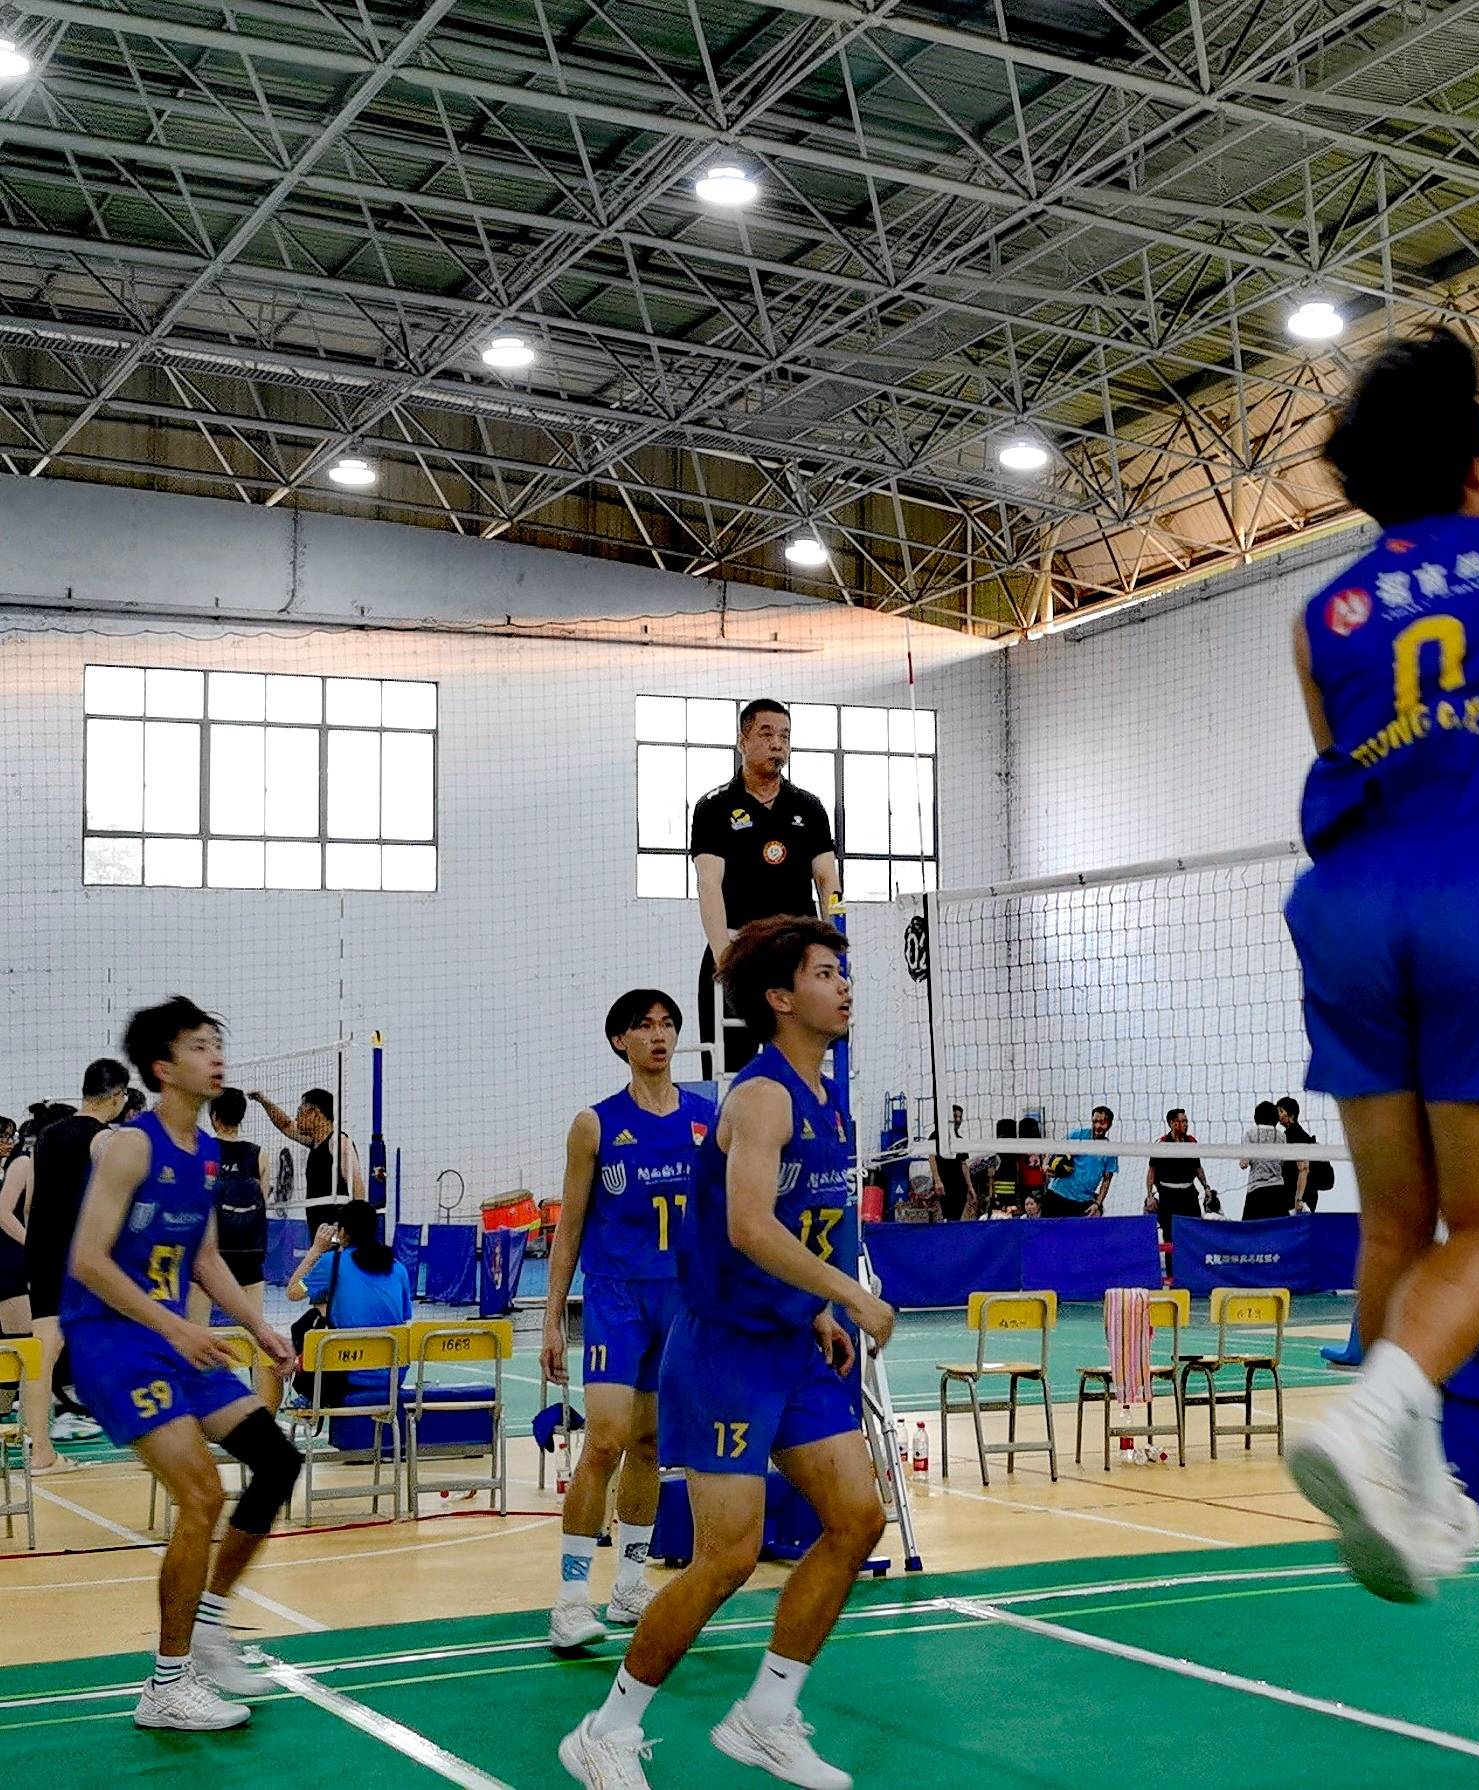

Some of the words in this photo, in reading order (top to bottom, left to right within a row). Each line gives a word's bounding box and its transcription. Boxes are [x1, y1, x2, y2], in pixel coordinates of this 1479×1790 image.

[589, 1344, 607, 1372] 11
[130, 1380, 173, 1419] 59
[713, 1421, 750, 1458] 13
